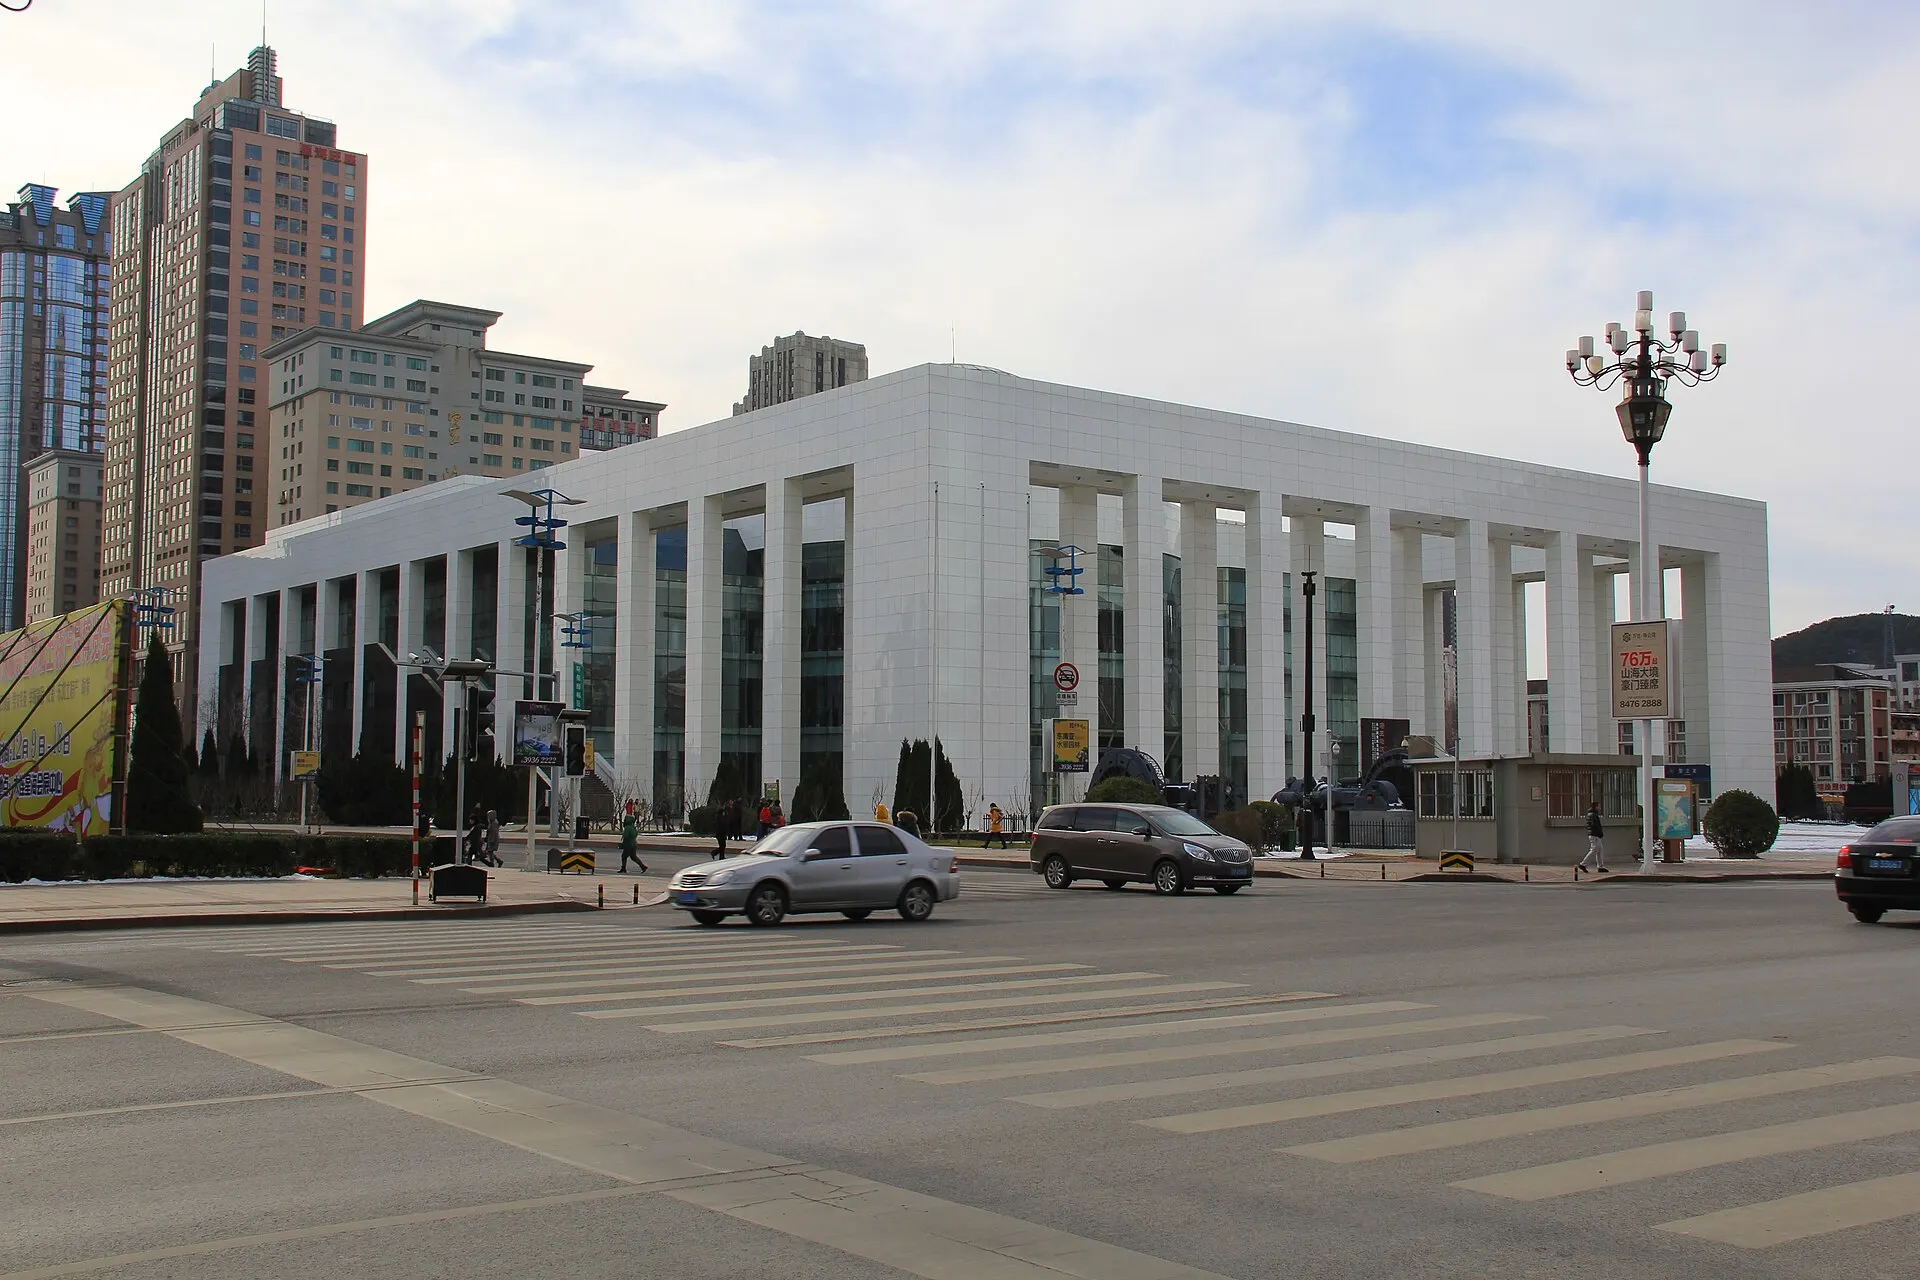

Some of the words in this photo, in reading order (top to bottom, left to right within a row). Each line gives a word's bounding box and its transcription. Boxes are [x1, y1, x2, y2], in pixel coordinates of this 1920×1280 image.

[1621, 667, 1659, 678] 山海大境
[1619, 700, 1640, 708] 8476
[1641, 699, 1662, 707] 2888
